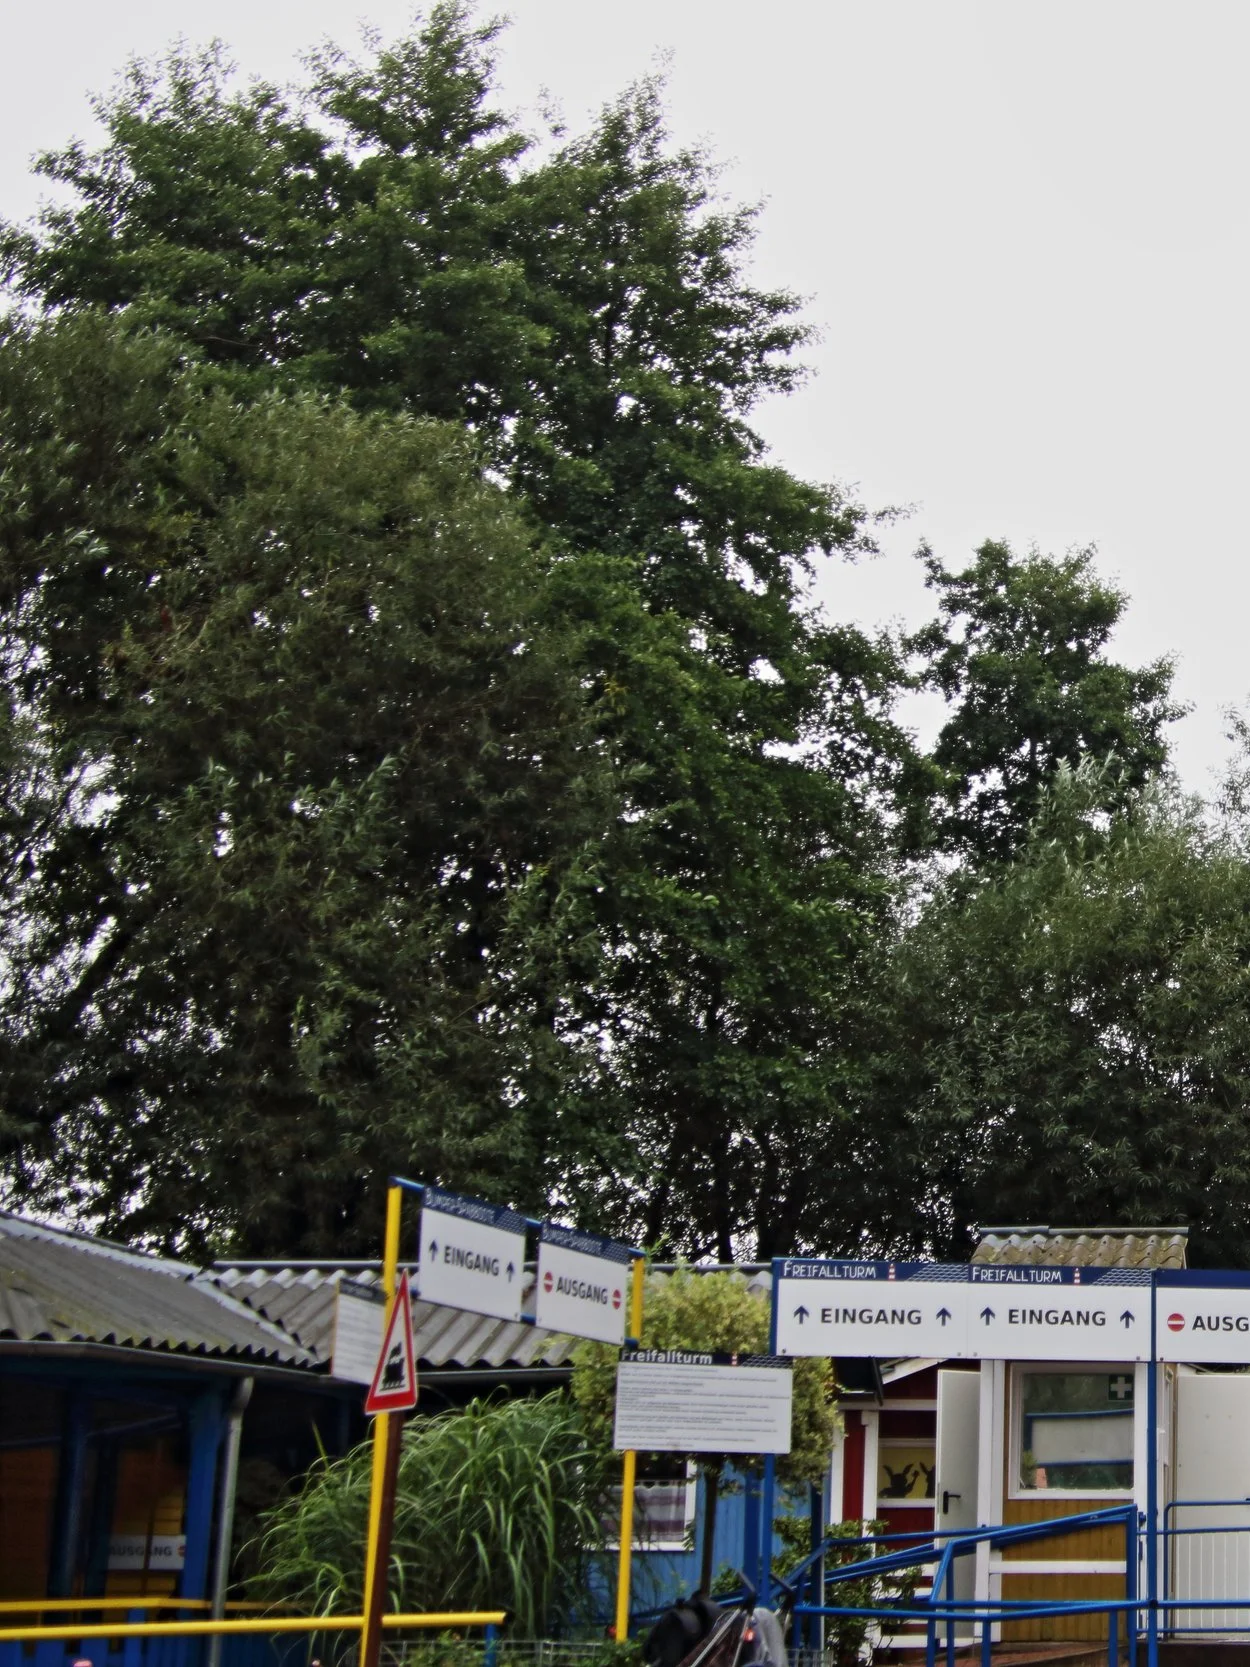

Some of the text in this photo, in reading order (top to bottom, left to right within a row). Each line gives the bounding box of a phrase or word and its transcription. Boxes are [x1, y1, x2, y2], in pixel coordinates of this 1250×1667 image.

[444, 1245, 499, 1276] EINGANG
[783, 1261, 876, 1278] FREIFALLTURM
[972, 1266, 1062, 1283] FREIFALLTURM
[556, 1276, 608, 1305] AUSGANG
[821, 1308, 922, 1325] EINGANG
[1008, 1309, 1106, 1327] EINGANG
[621, 1349, 713, 1365] Freifallturm
[110, 1545, 172, 1557] AUSGNG
